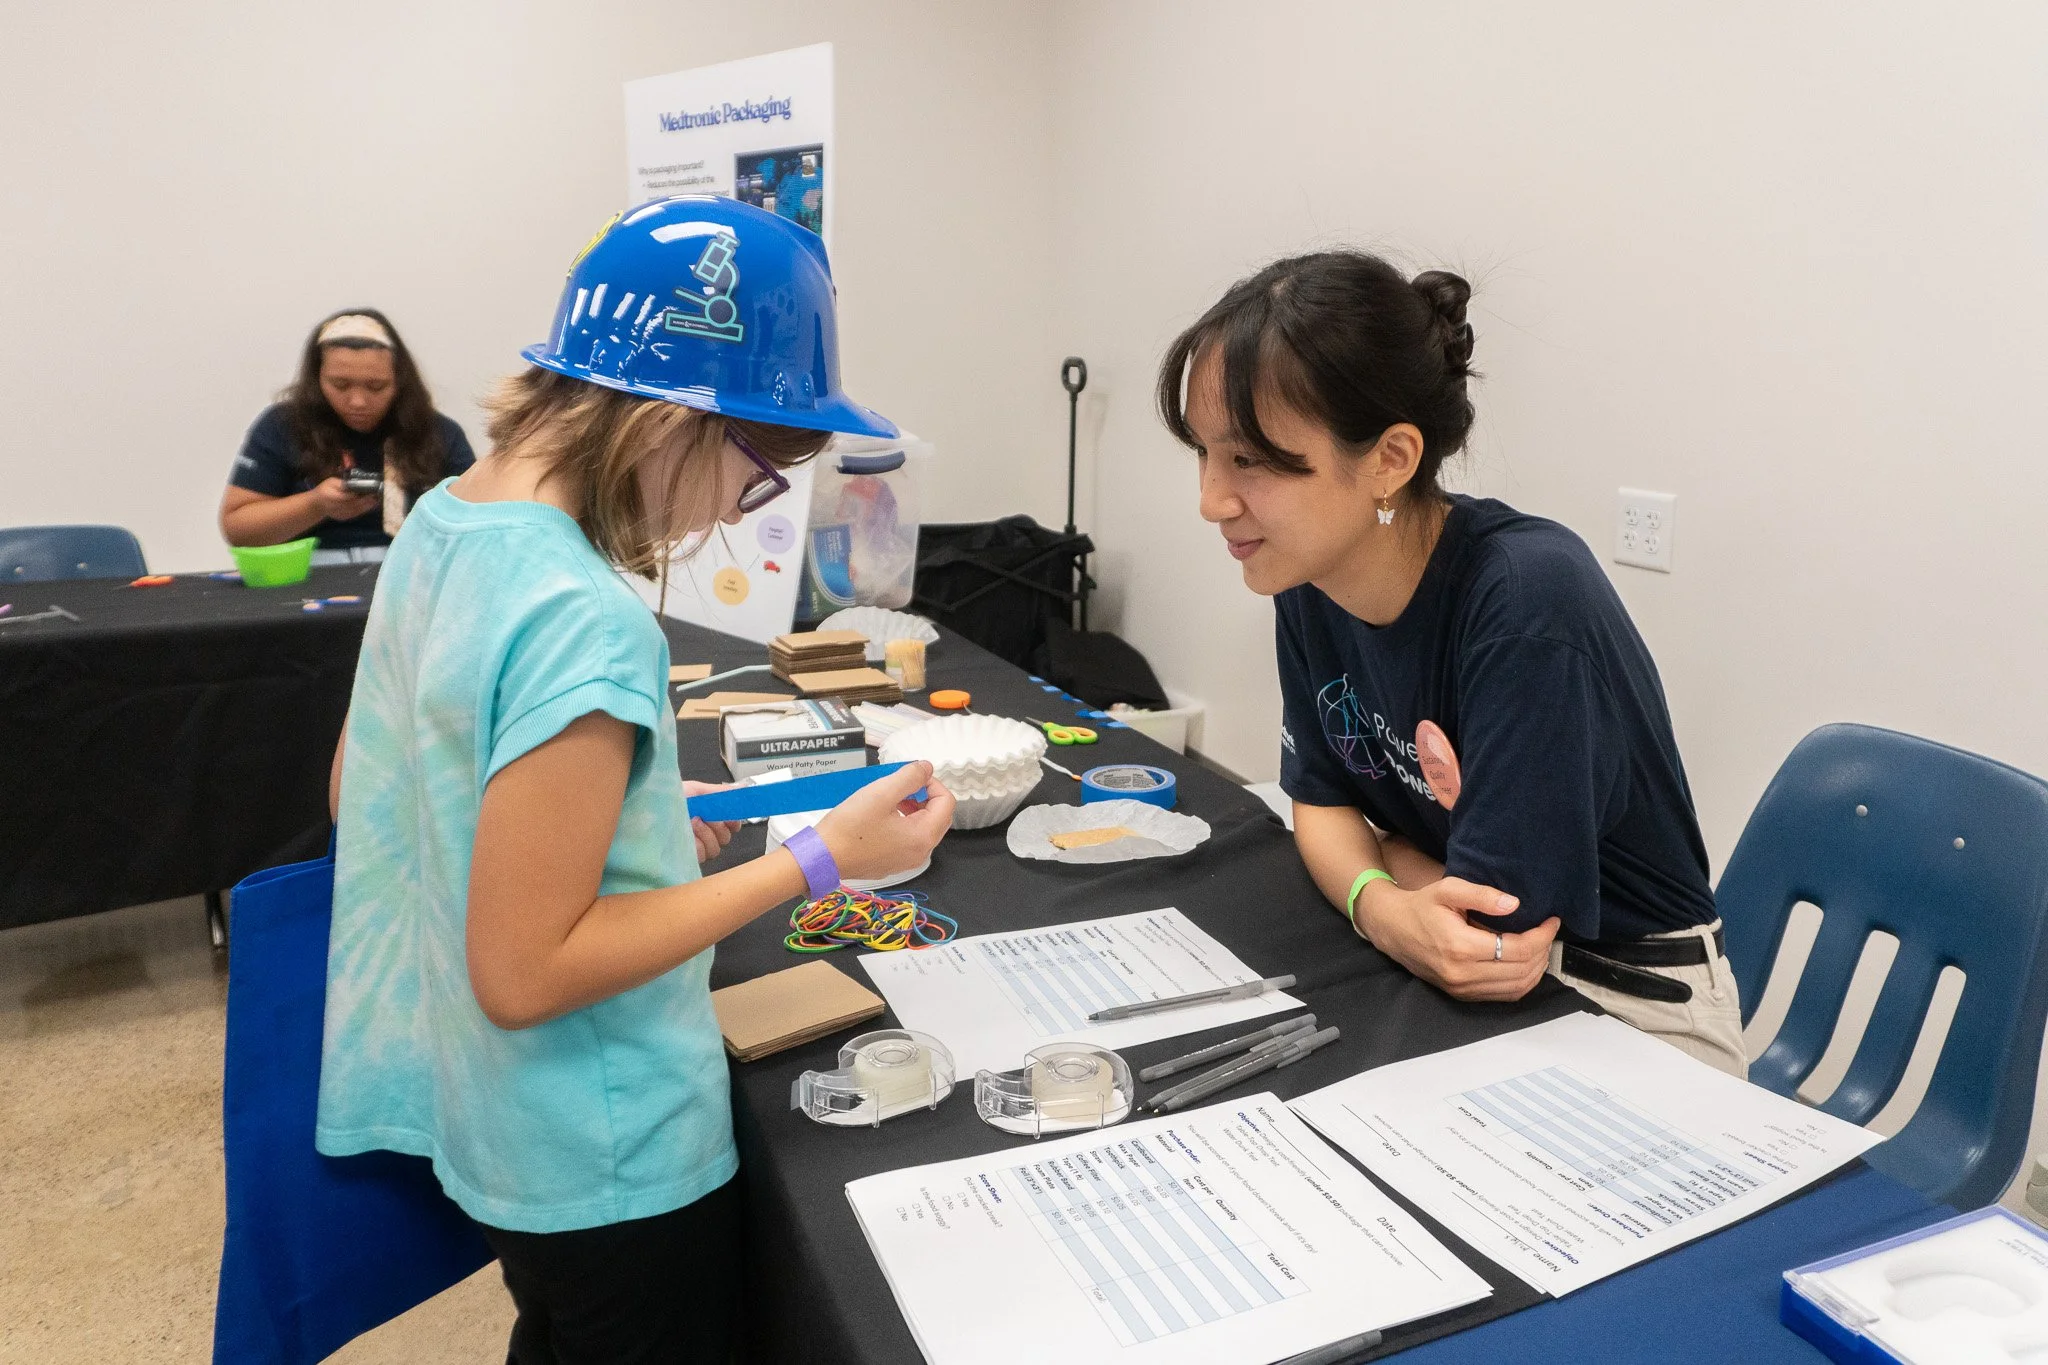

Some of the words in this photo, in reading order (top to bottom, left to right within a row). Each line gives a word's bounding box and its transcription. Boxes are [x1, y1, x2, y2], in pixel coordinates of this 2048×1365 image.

[659, 105, 720, 132] Medtronic
[722, 95, 791, 123] Packaging
[767, 763, 794, 771] Waxed
[795, 761, 814, 769] Patty
[815, 759, 837, 768] Paper
[1455, 1106, 1474, 1117] Cost
[1470, 1116, 1487, 1128] Total
[1166, 1130, 1187, 1149] Purchase
[1185, 1149, 1201, 1164] Order:
[1223, 1128, 1237, 1140] Water
[1235, 1139, 1249, 1152] Dunk
[1247, 1151, 1258, 1161] Test
[1382, 1142, 1401, 1157] Date
[1089, 1150, 1103, 1164] Straw
[1104, 1147, 1125, 1170] Toothpick
[1118, 1143, 1128, 1154] Wax
[1126, 1154, 1140, 1167] Paper
[1267, 1156, 1280, 1167] Test
[1524, 1152, 1553, 1170] Quantity
[1060, 1156, 1075, 1170] Tape
[1076, 1154, 1091, 1169] Coffee
[1088, 1169, 1101, 1181] Filter
[1131, 1140, 1155, 1164] Cardboard
[1168, 1181, 1184, 1195] $0.10
[1256, 1107, 1275, 1123] Name
[1376, 1217, 1396, 1233] Date
[1767, 1163, 1789, 1174] Score
[1019, 1167, 1030, 1177] Foil
[1033, 1164, 1046, 1177] Foam
[1043, 1177, 1055, 1189] Plate
[1048, 1161, 1064, 1177] Rubber
[1060, 1178, 1075, 1190] Band
[1435, 1163, 1456, 1180] $0.50)
[1555, 1172, 1573, 1181] per
[1707, 1169, 1727, 1181] Plate
[964, 1176, 975, 1186] Did
[1183, 1178, 1195, 1190] Item
[1237, 1112, 1261, 1133] Objective:
[1257, 1132, 1276, 1149] Design
[1304, 1177, 1324, 1192] (under
[1322, 1192, 1342, 1208] $0.50)
[1338, 1208, 1362, 1228] package
[1361, 1228, 1374, 1238] that
[1371, 1238, 1384, 1248] can
[1569, 1180, 1586, 1191] Cost
[1578, 1177, 1594, 1189] Item
[1727, 1180, 1748, 1192] Foam
[1742, 1178, 1759, 1187] Foil
[968, 1185, 980, 1194] the
[978, 1174, 991, 1187] Score
[988, 1187, 1002, 1203] Sheet:
[1456, 1180, 1478, 1196] (under
[921, 1190, 932, 1201] the
[928, 1199, 939, 1212] food
[960, 1197, 972, 1208] Yes
[975, 1193, 990, 1211] cracker
[1644, 1196, 1666, 1209] Paper
[1691, 1191, 1716, 1206] Coffee
[1708, 1190, 1726, 1202] Tape
[944, 1201, 956, 1211] No
[1155, 1134, 1175, 1153] Material
[1193, 1175, 1206, 1187] Cost
[1201, 1186, 1214, 1195] per
[1215, 1199, 1238, 1221] Quantity
[1267, 1252, 1284, 1267] Total
[1280, 1267, 1295, 1280] Cost
[1587, 1204, 1611, 1218] Order:
[1632, 1200, 1672, 1224] Cardboard
[1658, 1193, 1694, 1216] Toothpick
[1683, 1198, 1706, 1211] Straw
[898, 1212, 910, 1222] No
[914, 1208, 926, 1220] Yes
[986, 1211, 1003, 1227] break?
[1667, 1209, 1683, 1220] Wax
[1611, 1218, 1645, 1239] Purchase
[1620, 1213, 1653, 1232] Material
[1542, 1240, 1579, 1264] Objective:
[1533, 1251, 1561, 1272] Name
